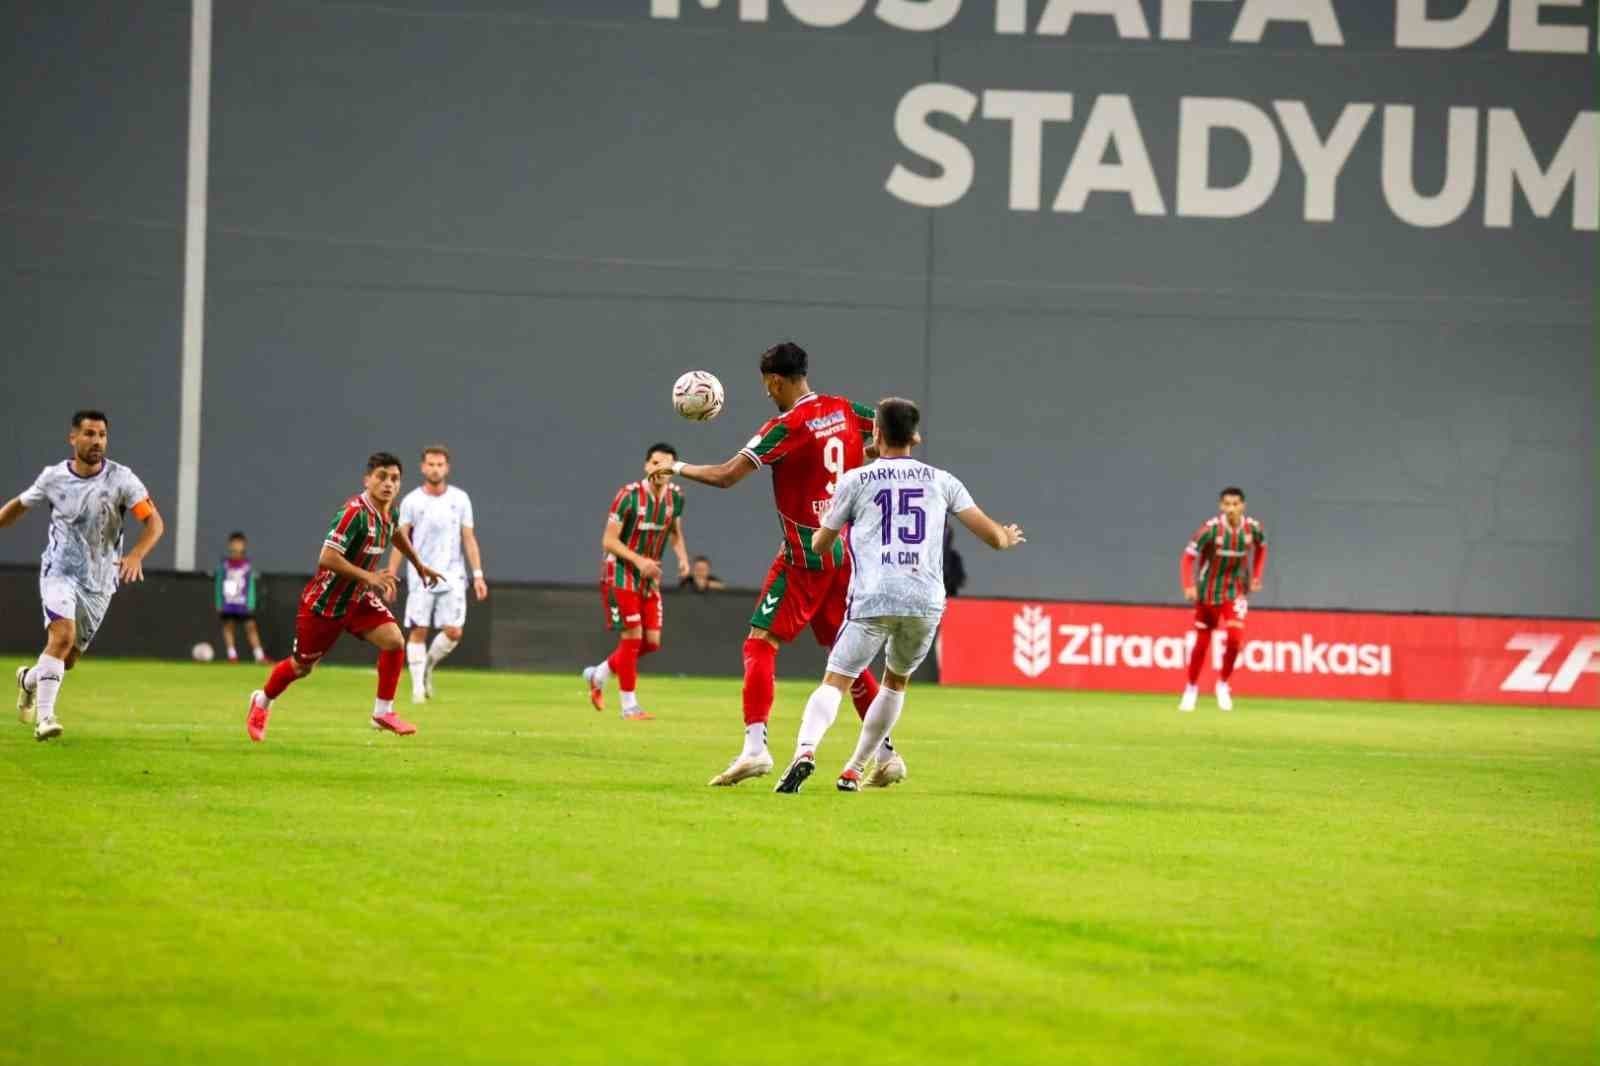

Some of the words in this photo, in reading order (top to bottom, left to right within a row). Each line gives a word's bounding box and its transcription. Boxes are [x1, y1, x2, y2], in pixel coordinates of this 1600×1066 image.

[885, 83, 1600, 231] STADYUM
[824, 436, 845, 495] 9
[873, 488, 926, 546] 15
[898, 551, 920, 565] CAN
